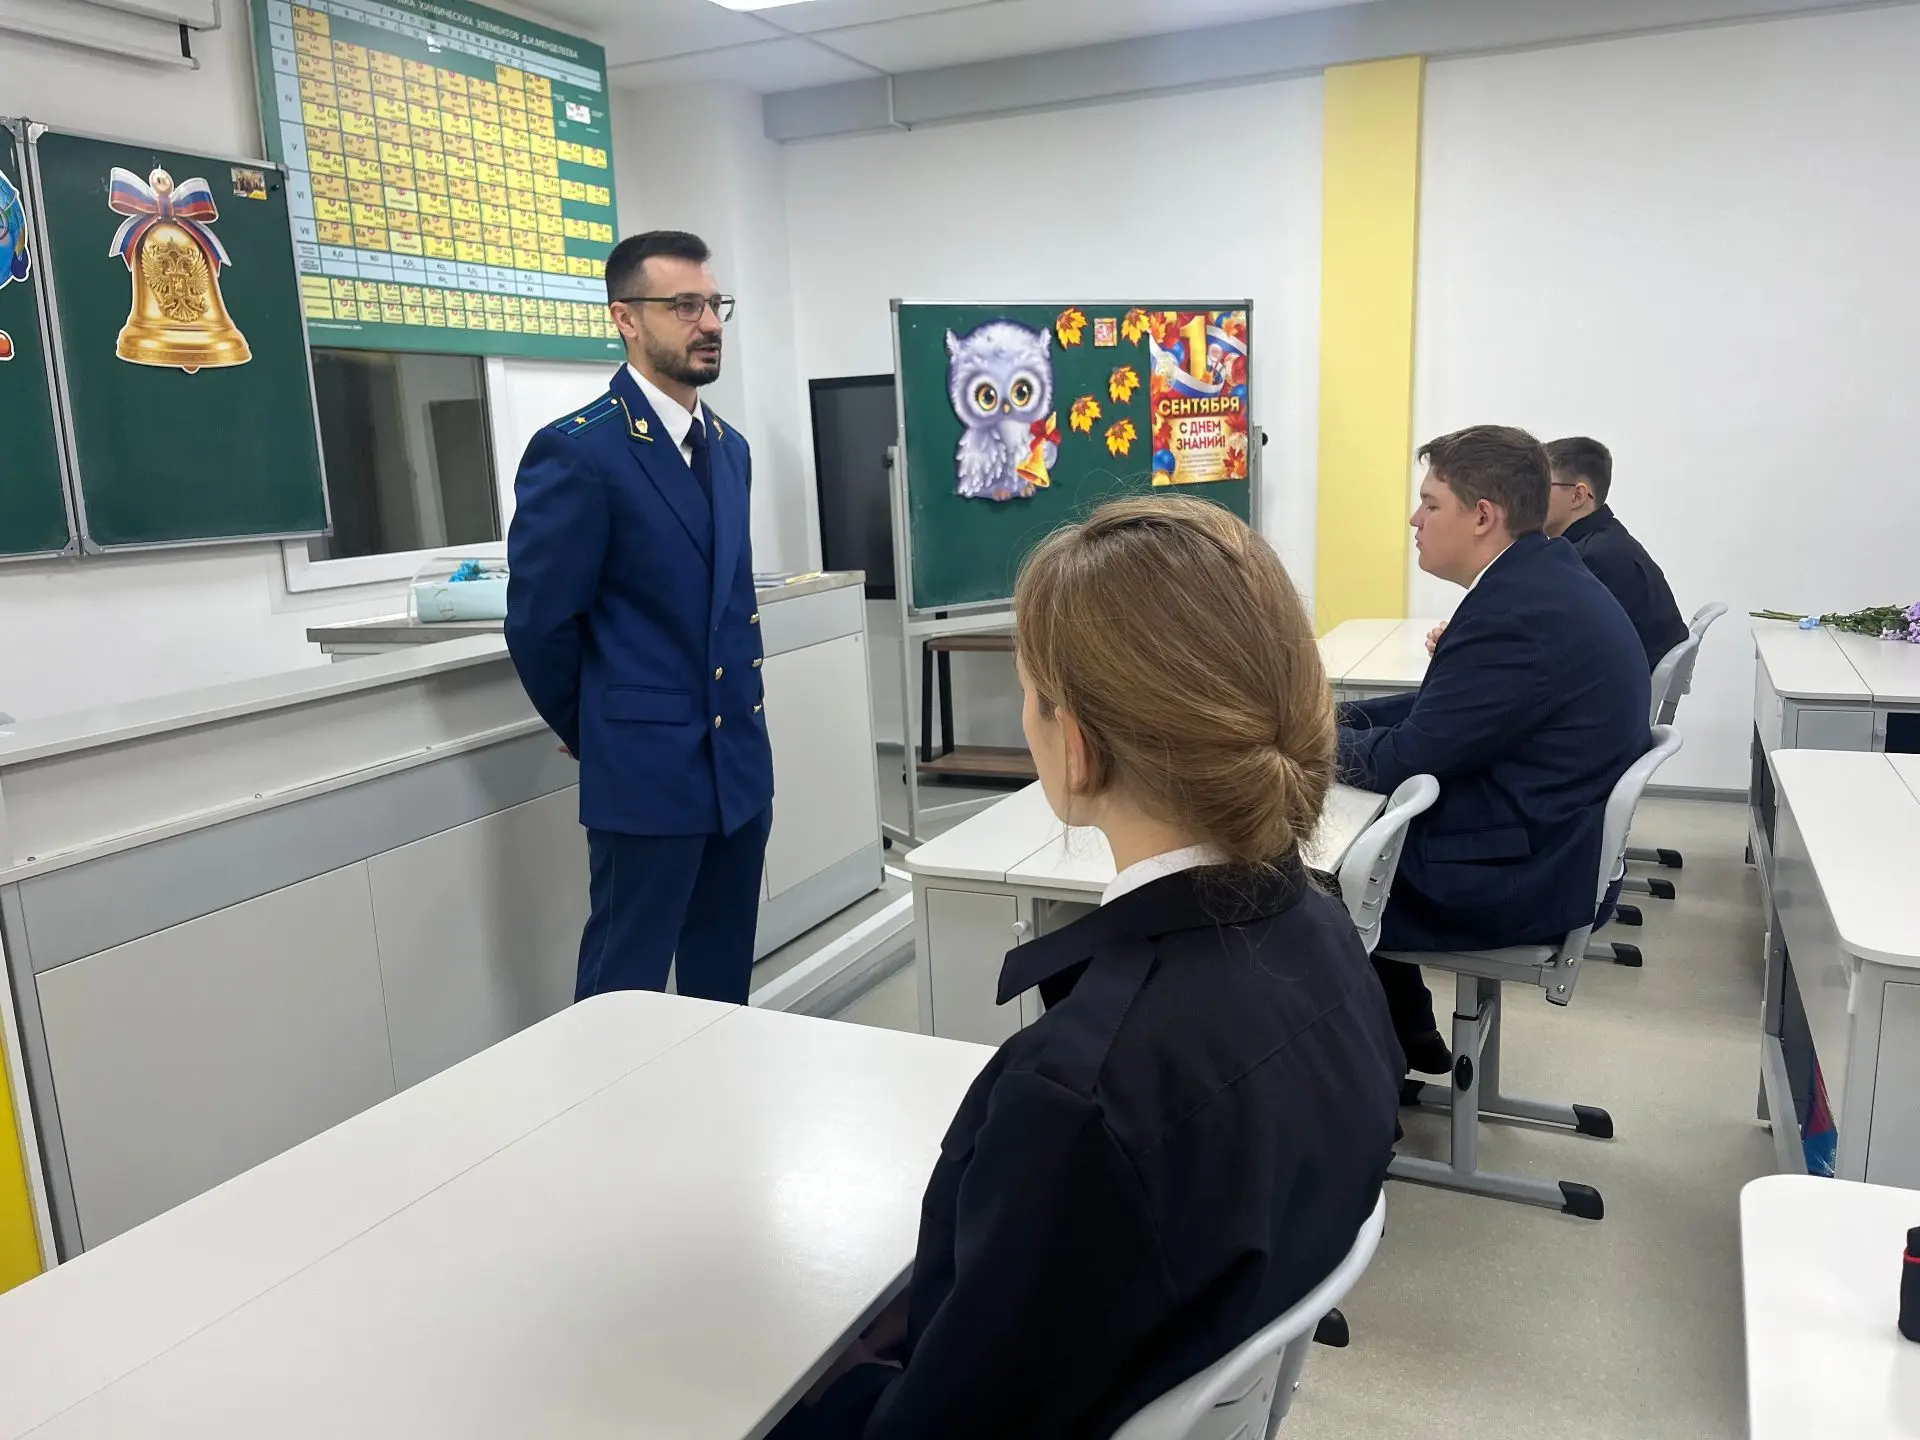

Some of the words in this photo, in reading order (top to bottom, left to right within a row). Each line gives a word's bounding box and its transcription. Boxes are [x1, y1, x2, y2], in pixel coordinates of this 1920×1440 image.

[420, 2, 474, 26] ХИМИЧЕСКИХ
[476, 19, 520, 41] ЭЛЕМЕНТОВ
[1180, 315, 1206, 379] 1
[1158, 396, 1240, 416] СЕНТЯБРЯ
[1179, 422, 1188, 434] С
[1190, 420, 1222, 436] ДНЕМ
[1176, 434, 1226, 450] ЗНАНИЙ!
